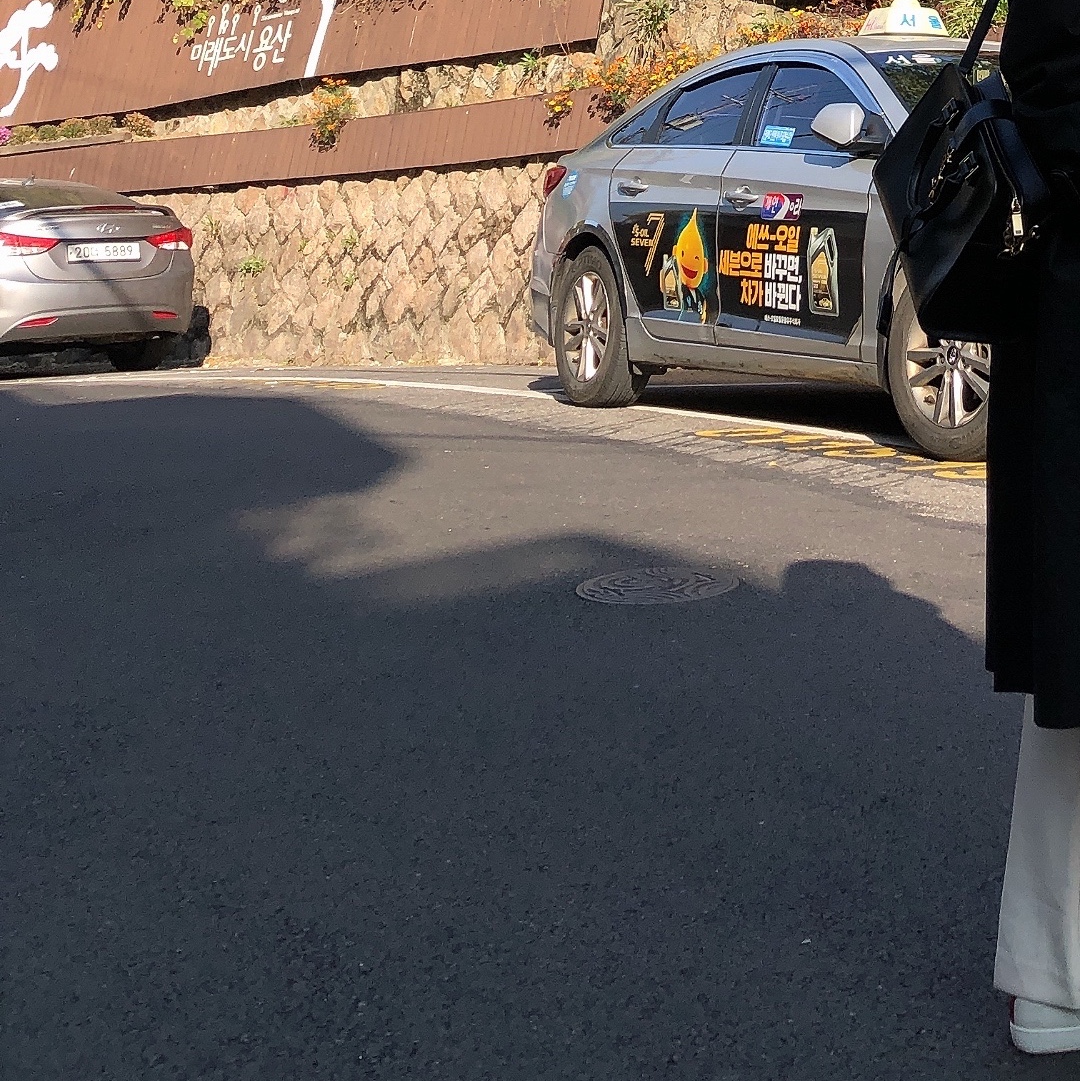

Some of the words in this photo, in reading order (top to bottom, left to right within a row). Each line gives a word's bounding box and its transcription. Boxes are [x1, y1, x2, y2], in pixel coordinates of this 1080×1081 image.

[190, 29, 254, 77] 미래도시
[252, 20, 293, 72] 용산
[746, 224, 801, 253] 에쓰-오일
[719, 248, 763, 279] 세븐으로
[764, 253, 803, 284] 바꾸면,
[740, 279, 764, 308] 차가
[765, 281, 802, 312] 바뀐다
